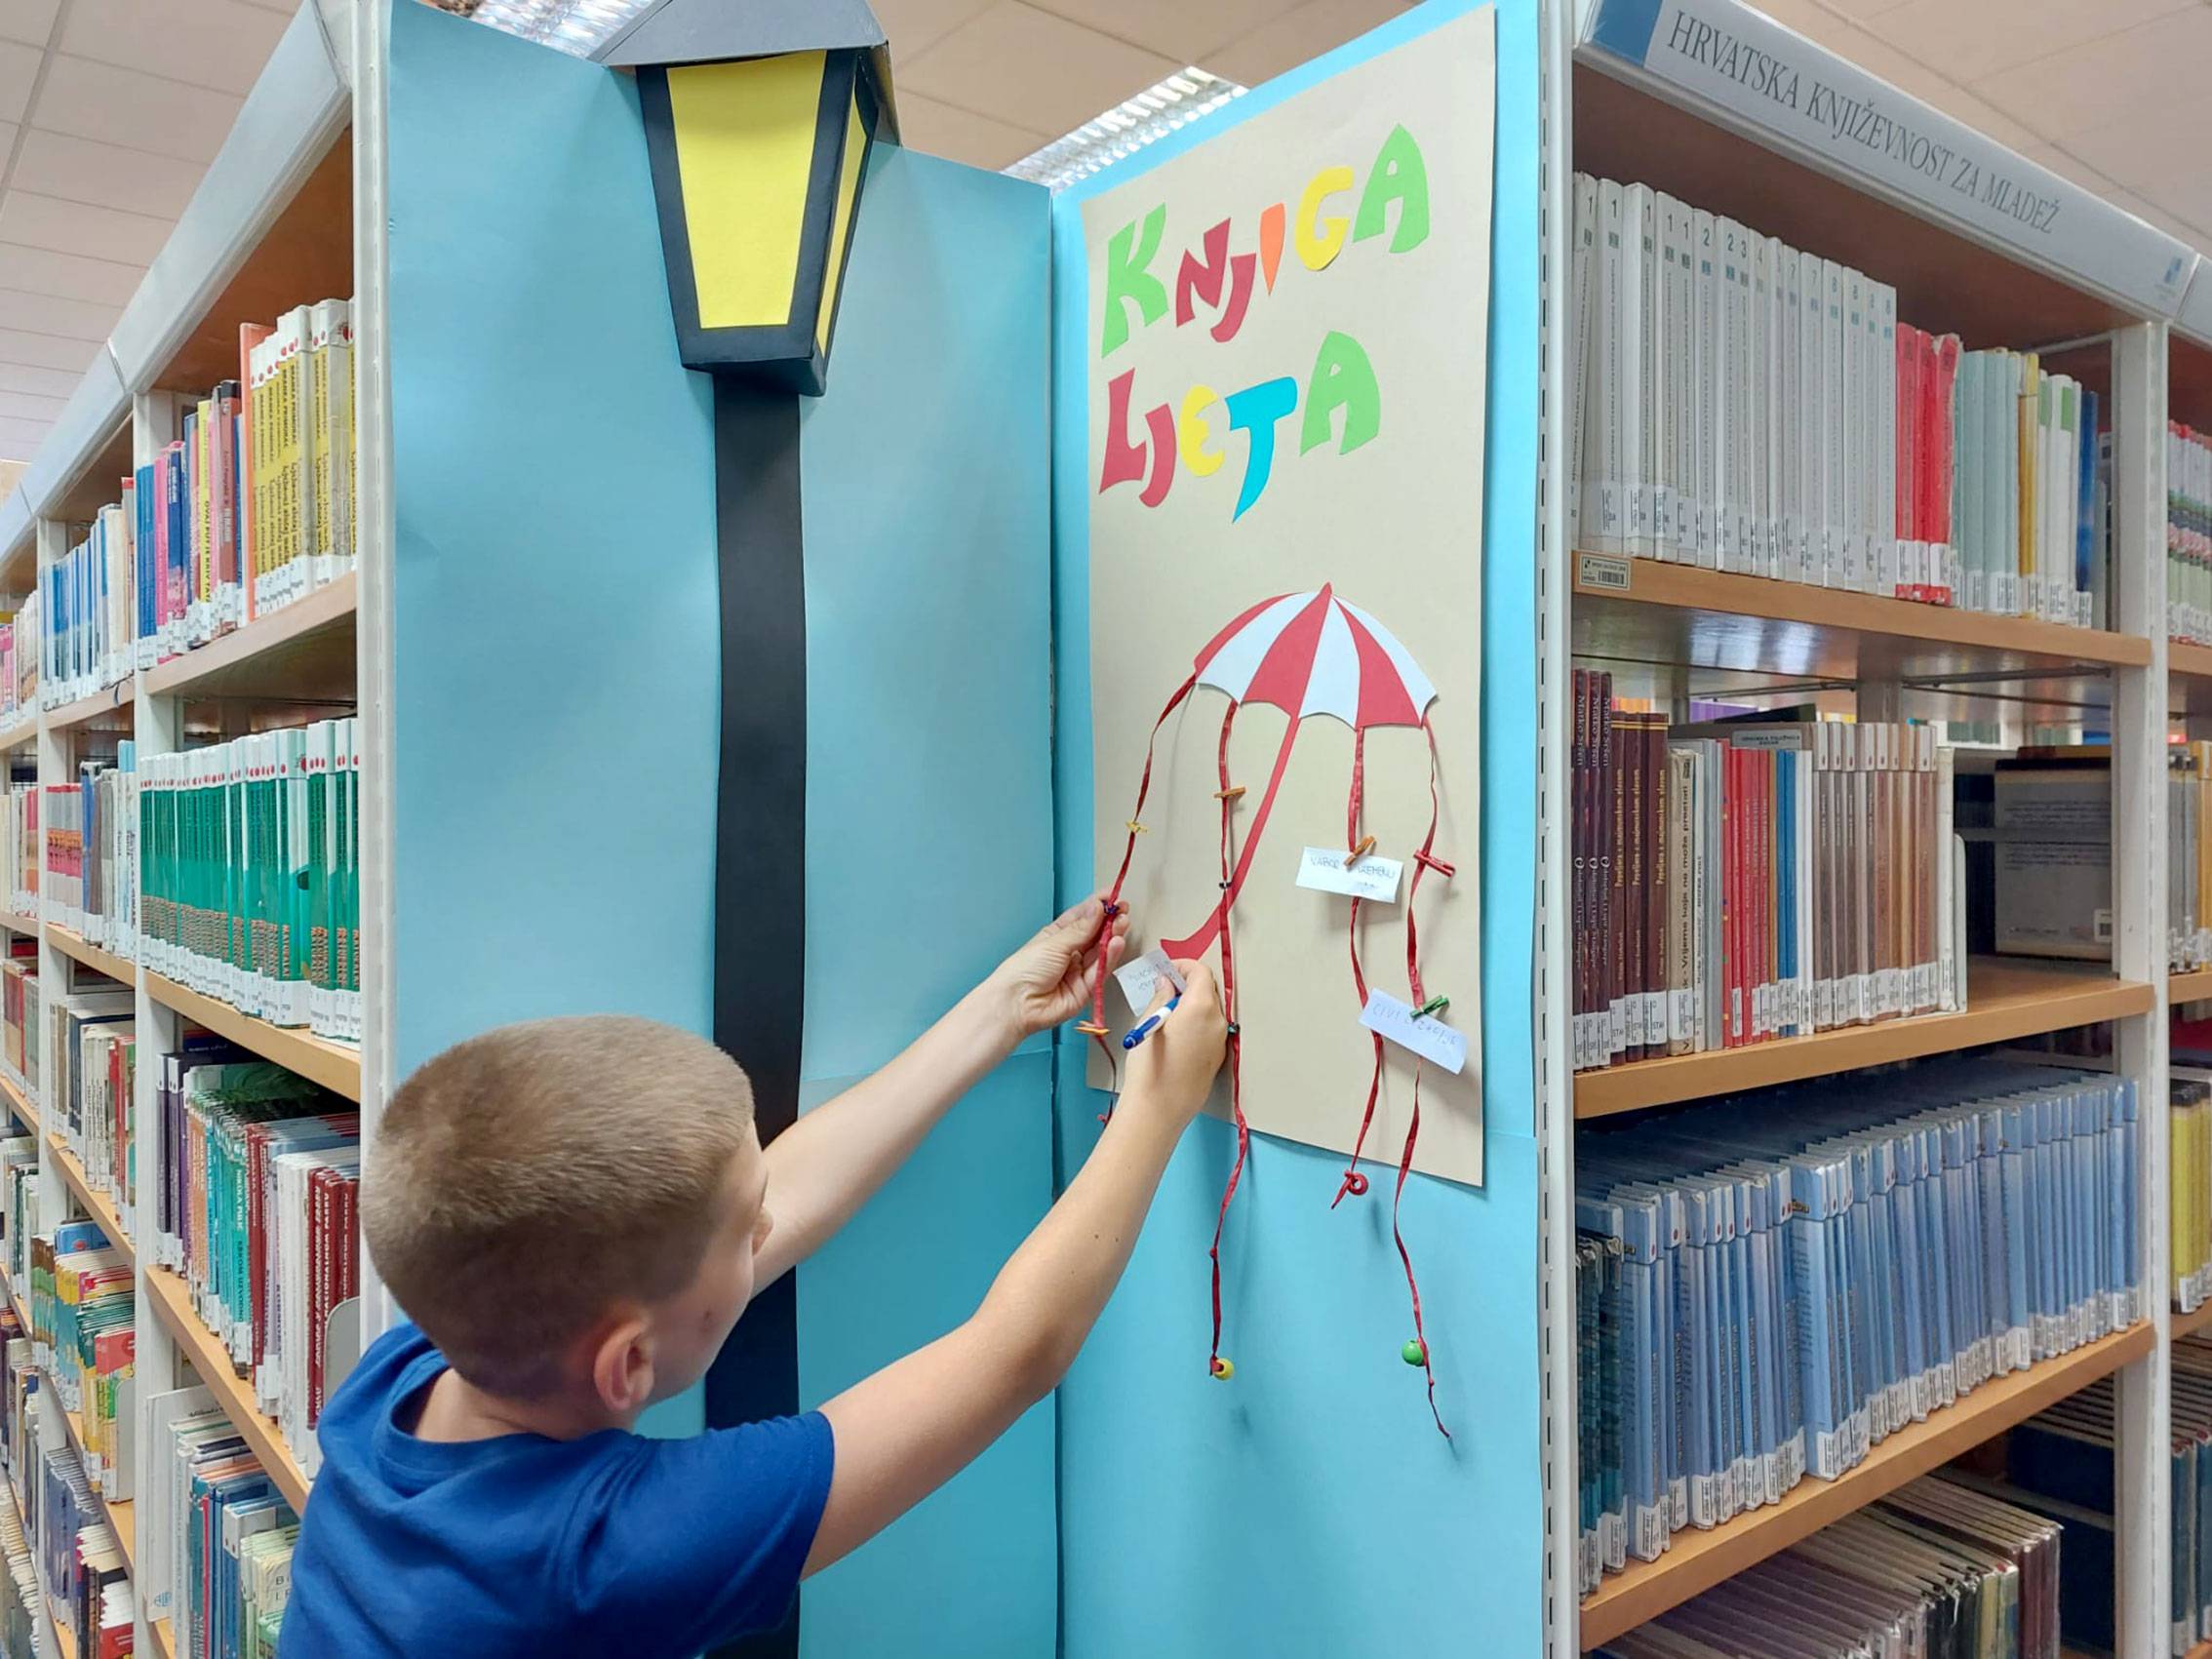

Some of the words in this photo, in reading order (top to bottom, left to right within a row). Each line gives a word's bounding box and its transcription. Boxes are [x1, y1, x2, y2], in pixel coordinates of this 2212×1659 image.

[1667, 10, 1798, 110] HRVATSKA
[1805, 81, 1955, 181] KNJIŽEVNOST
[1951, 157, 1979, 198] ZA
[1981, 173, 2061, 235] MLADEŽ
[1101, 123, 1430, 360] KNJIGA
[1703, 228, 1710, 247] 2
[1727, 233, 1734, 252] 2
[1099, 330, 1381, 524] LJETA
